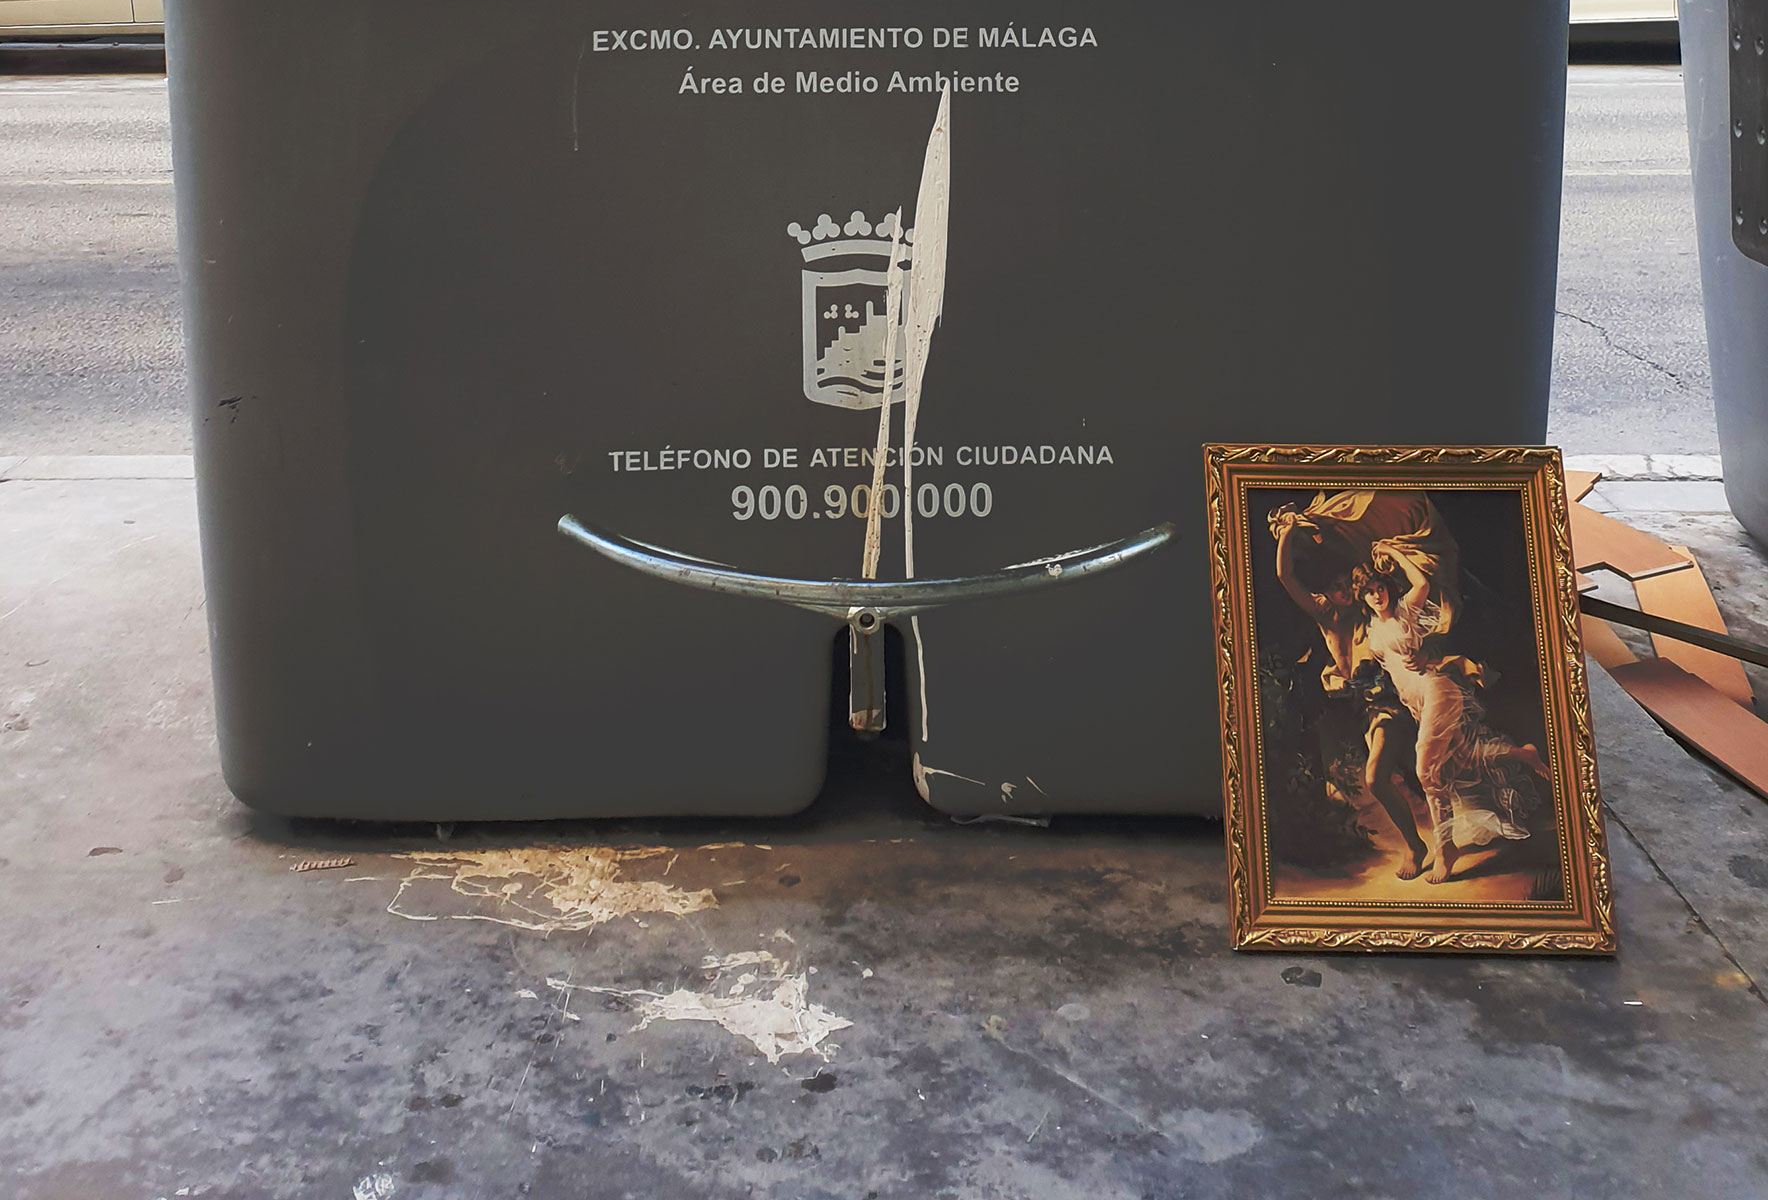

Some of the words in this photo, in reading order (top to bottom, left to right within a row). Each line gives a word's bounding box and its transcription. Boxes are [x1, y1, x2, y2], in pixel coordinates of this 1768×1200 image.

[593, 29, 700, 51] EXCMO.
[709, 28, 923, 49] AYUNTAMIENTO
[934, 28, 969, 49] DE
[979, 22, 1098, 48] MÁLAGA
[679, 66, 743, 94] Área
[753, 71, 786, 94] de
[797, 70, 879, 93] Medio
[887, 70, 1020, 93] Ambiente
[608, 445, 752, 471] TELÉFONO
[764, 448, 798, 468] DE
[810, 441, 943, 468] ATENCIÓN
[957, 445, 1114, 466] CIUDADANA
